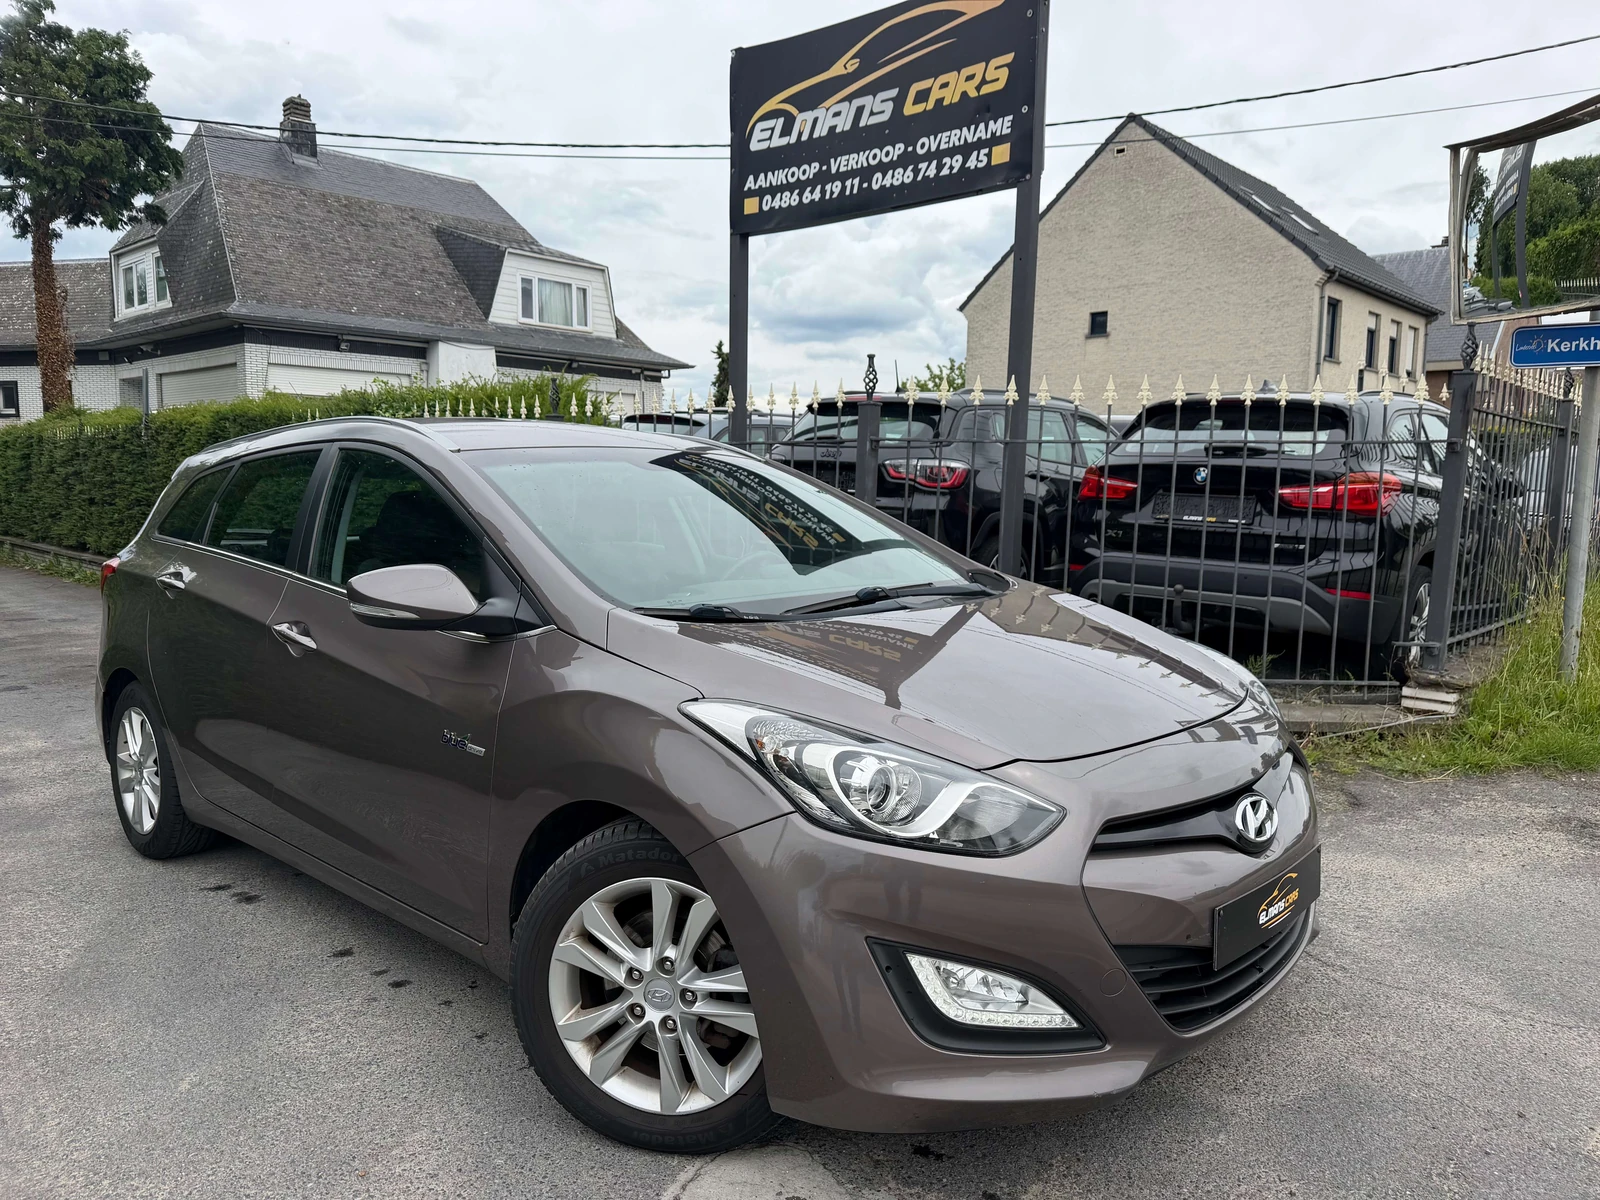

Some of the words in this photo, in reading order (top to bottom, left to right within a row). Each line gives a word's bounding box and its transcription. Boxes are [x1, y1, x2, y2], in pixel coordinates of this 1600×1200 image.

[749, 87, 899, 152] ELMANS
[903, 52, 1015, 116] CARS
[744, 162, 819, 191] AANKOOP
[830, 143, 905, 174] VERKOOP
[916, 115, 1013, 155] OVERNAME
[762, 188, 799, 211] 0486
[802, 185, 821, 204] 64
[825, 181, 842, 199] 19
[845, 176, 860, 195] 11
[871, 165, 914, 190] 0486
[917, 160, 937, 181] 74
[939, 154, 963, 176] 29
[965, 148, 989, 169] 45
[598, 847, 680, 868] Matador
[1259, 898, 1285, 925] ELMANS
